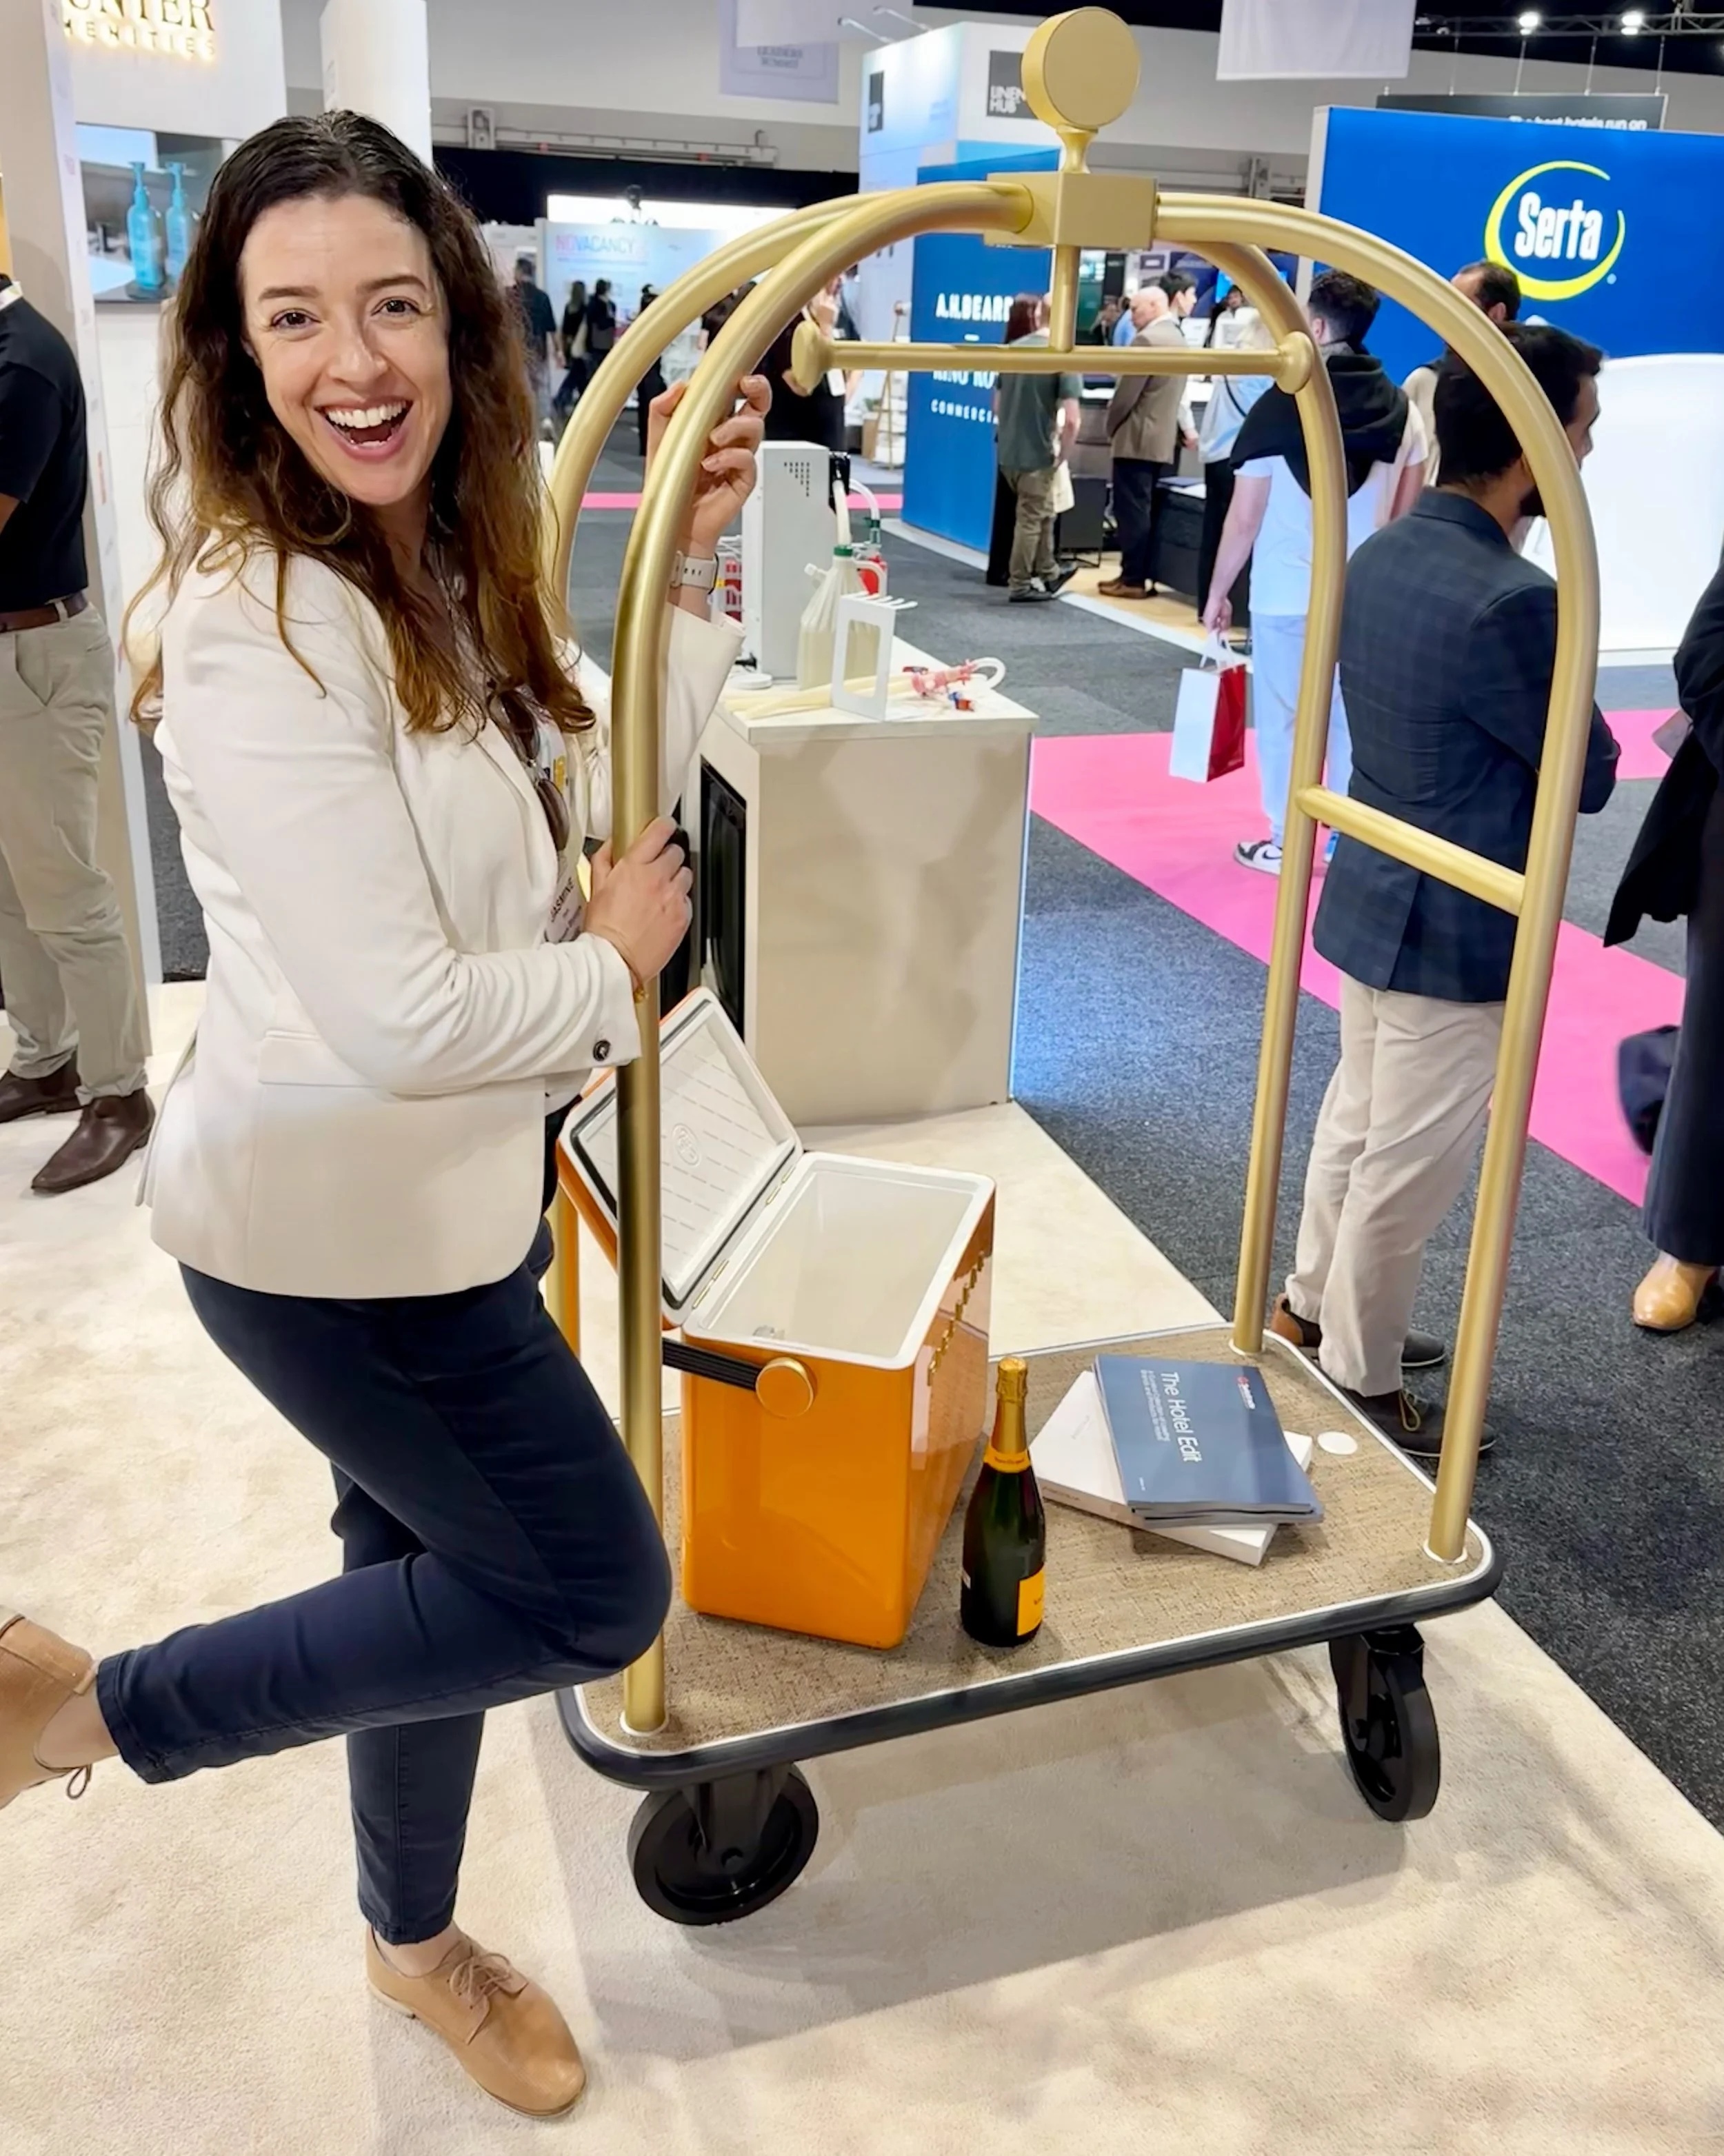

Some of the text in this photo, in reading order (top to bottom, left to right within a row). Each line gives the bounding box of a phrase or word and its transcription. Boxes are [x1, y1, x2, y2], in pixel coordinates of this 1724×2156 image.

[989, 98, 1017, 114] HUB
[1605, 119, 1627, 130] run
[1628, 119, 1647, 131] on
[1514, 192, 1603, 261] Serta
[1160, 1371, 1203, 1462] The Hotel Edit
